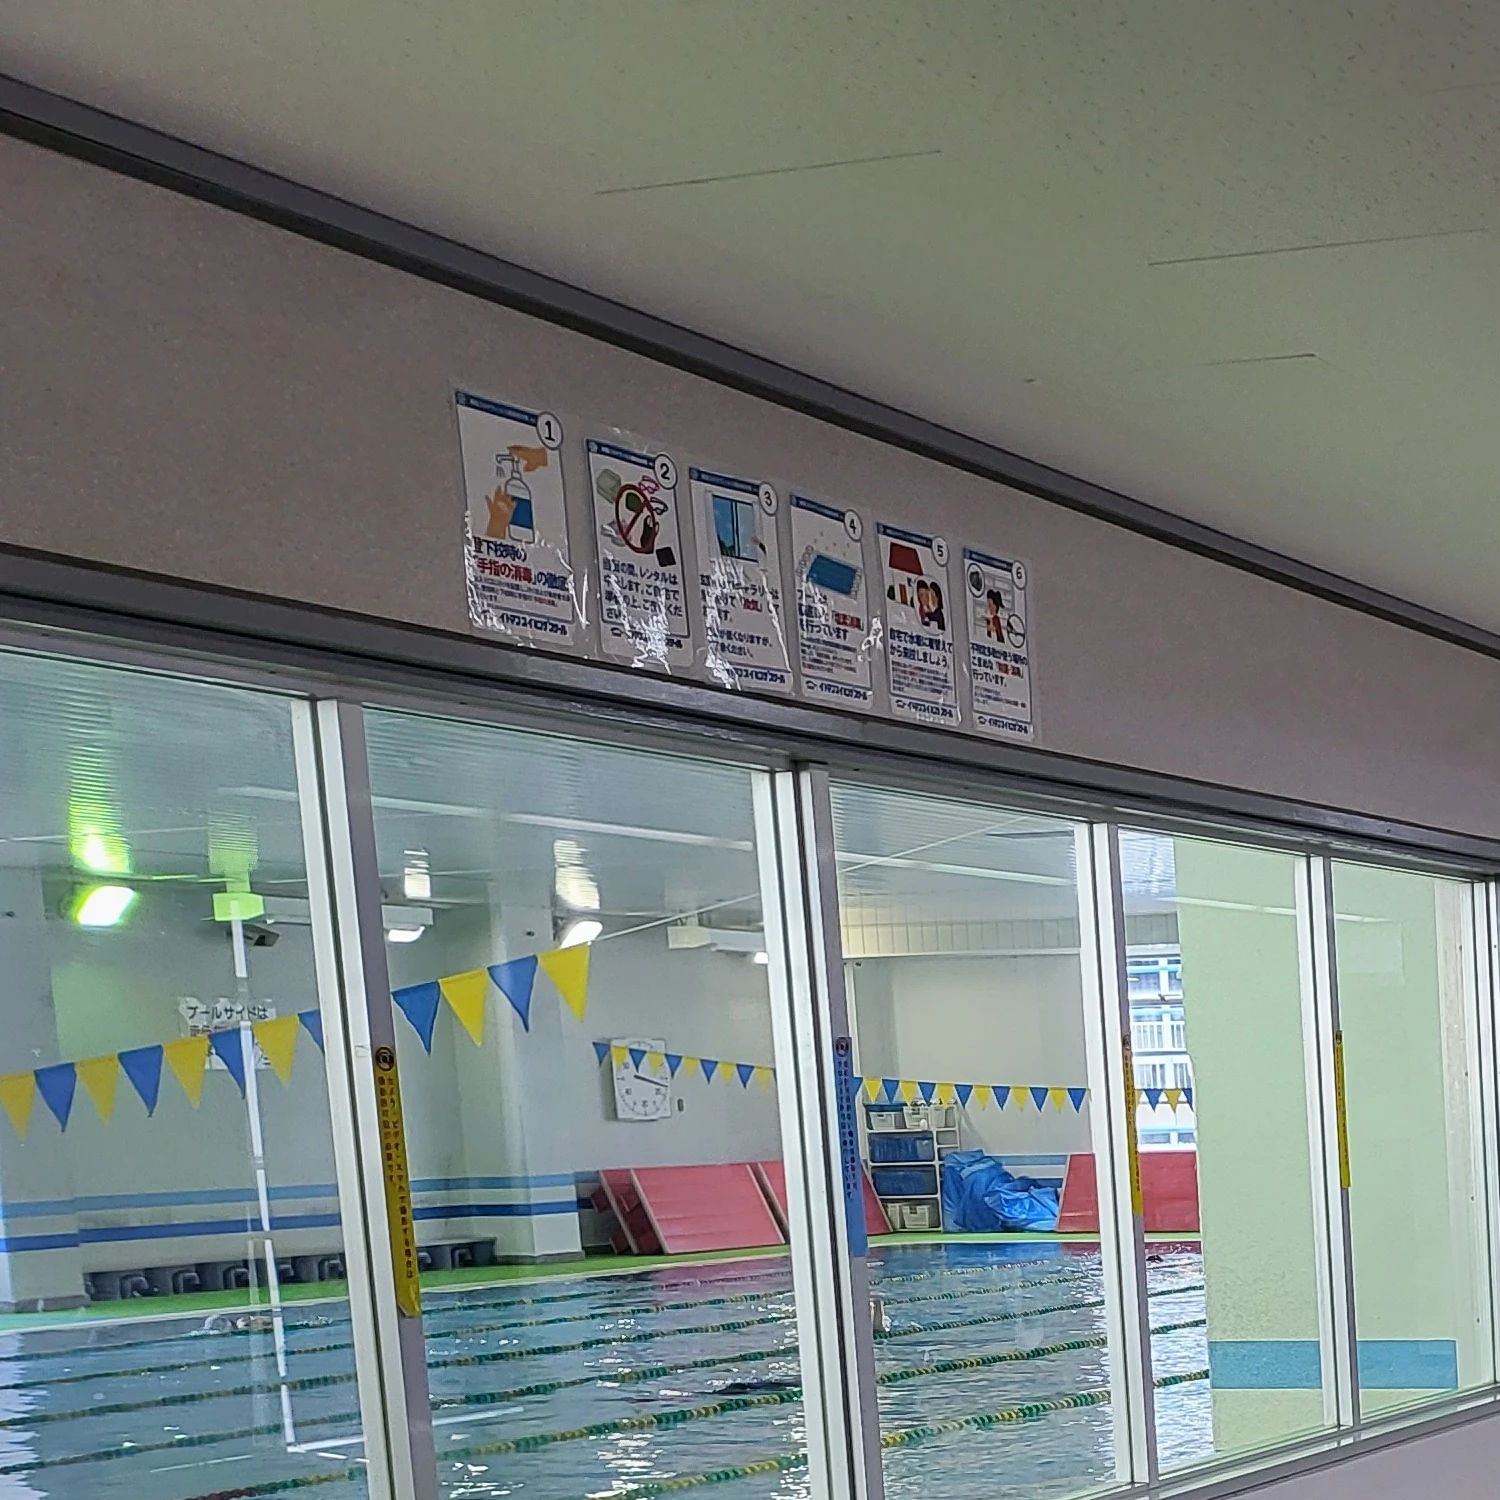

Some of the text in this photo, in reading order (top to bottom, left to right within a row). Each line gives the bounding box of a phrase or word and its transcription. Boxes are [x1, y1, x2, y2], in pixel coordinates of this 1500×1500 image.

[544, 420, 556, 442] 1
[660, 463, 670, 480] 2
[764, 491, 773, 507] 3
[849, 519, 857, 534] 4
